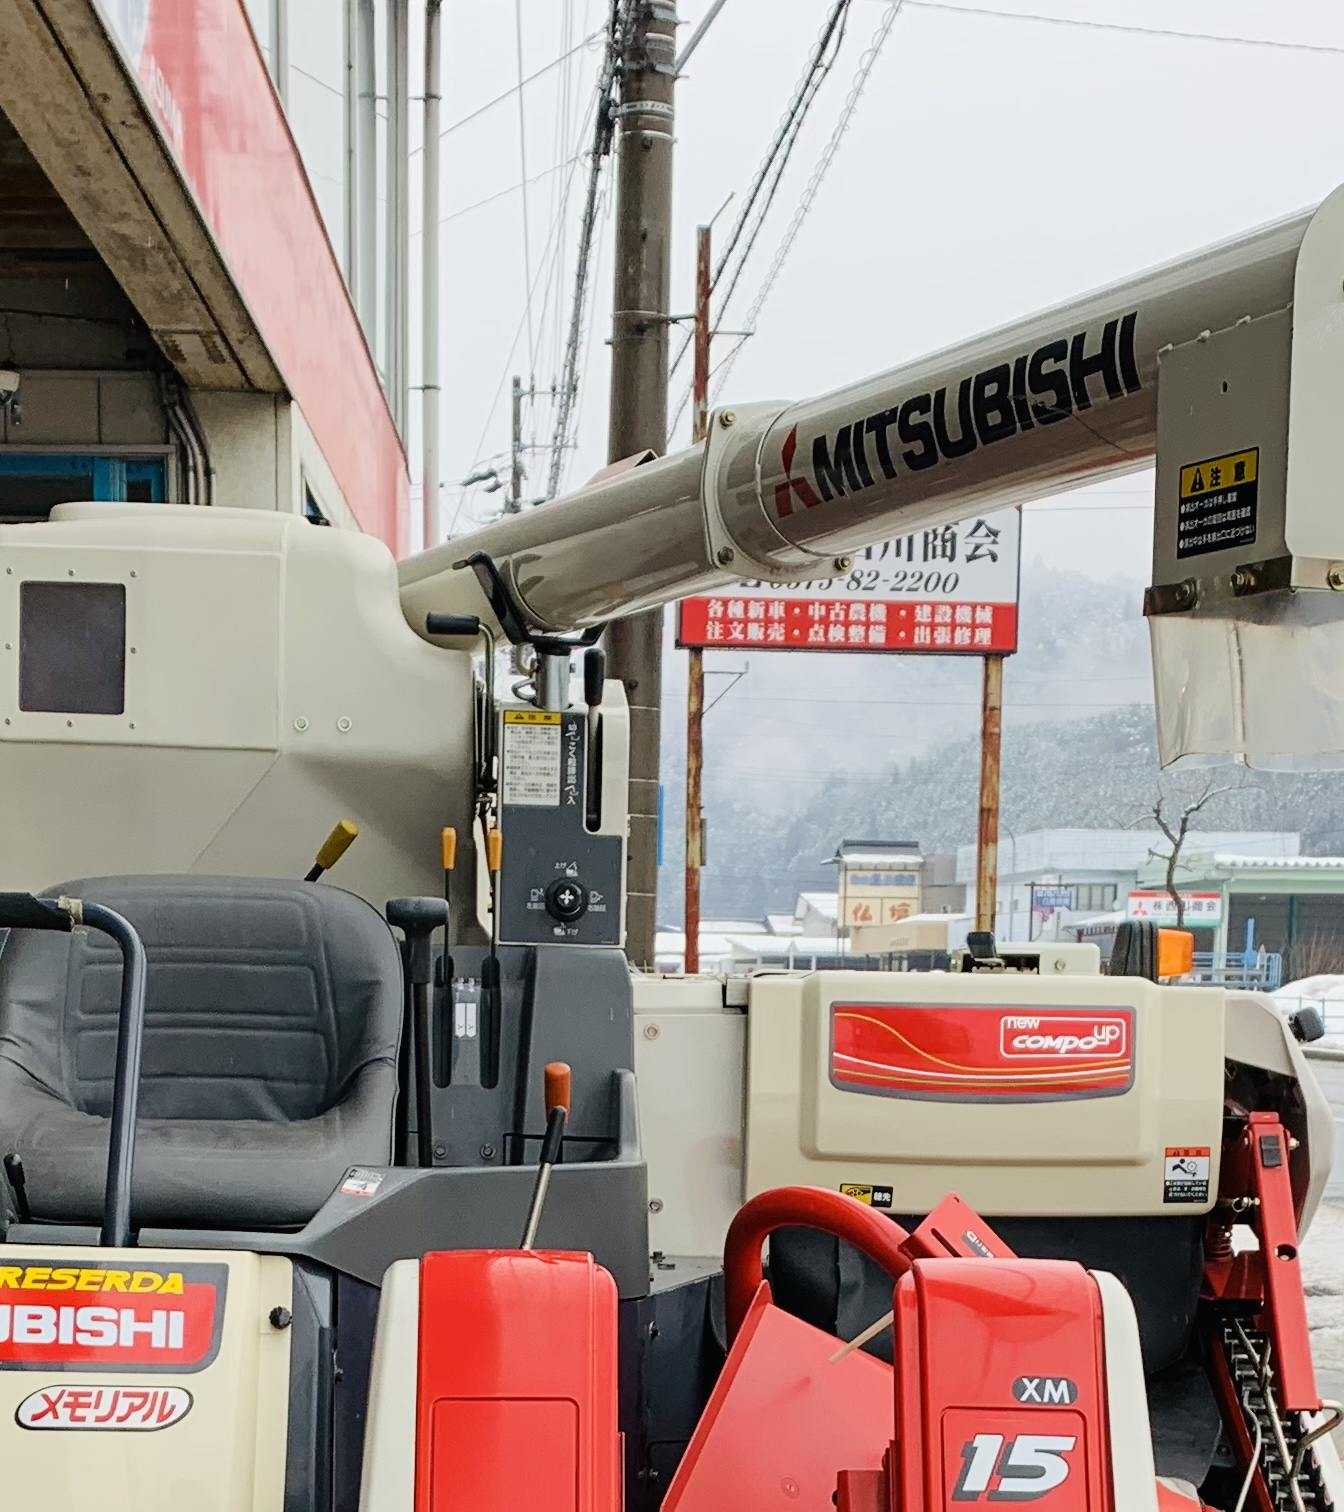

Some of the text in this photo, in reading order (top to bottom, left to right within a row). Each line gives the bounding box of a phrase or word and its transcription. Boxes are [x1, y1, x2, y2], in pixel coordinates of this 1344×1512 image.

[813, 311, 1142, 502] MITSUBISHI
[1007, 1018, 1041, 1029] new
[31, 1389, 176, 1423] メモリアル
[1020, 1377, 1071, 1404] XM
[960, 1434, 1077, 1493] 15
